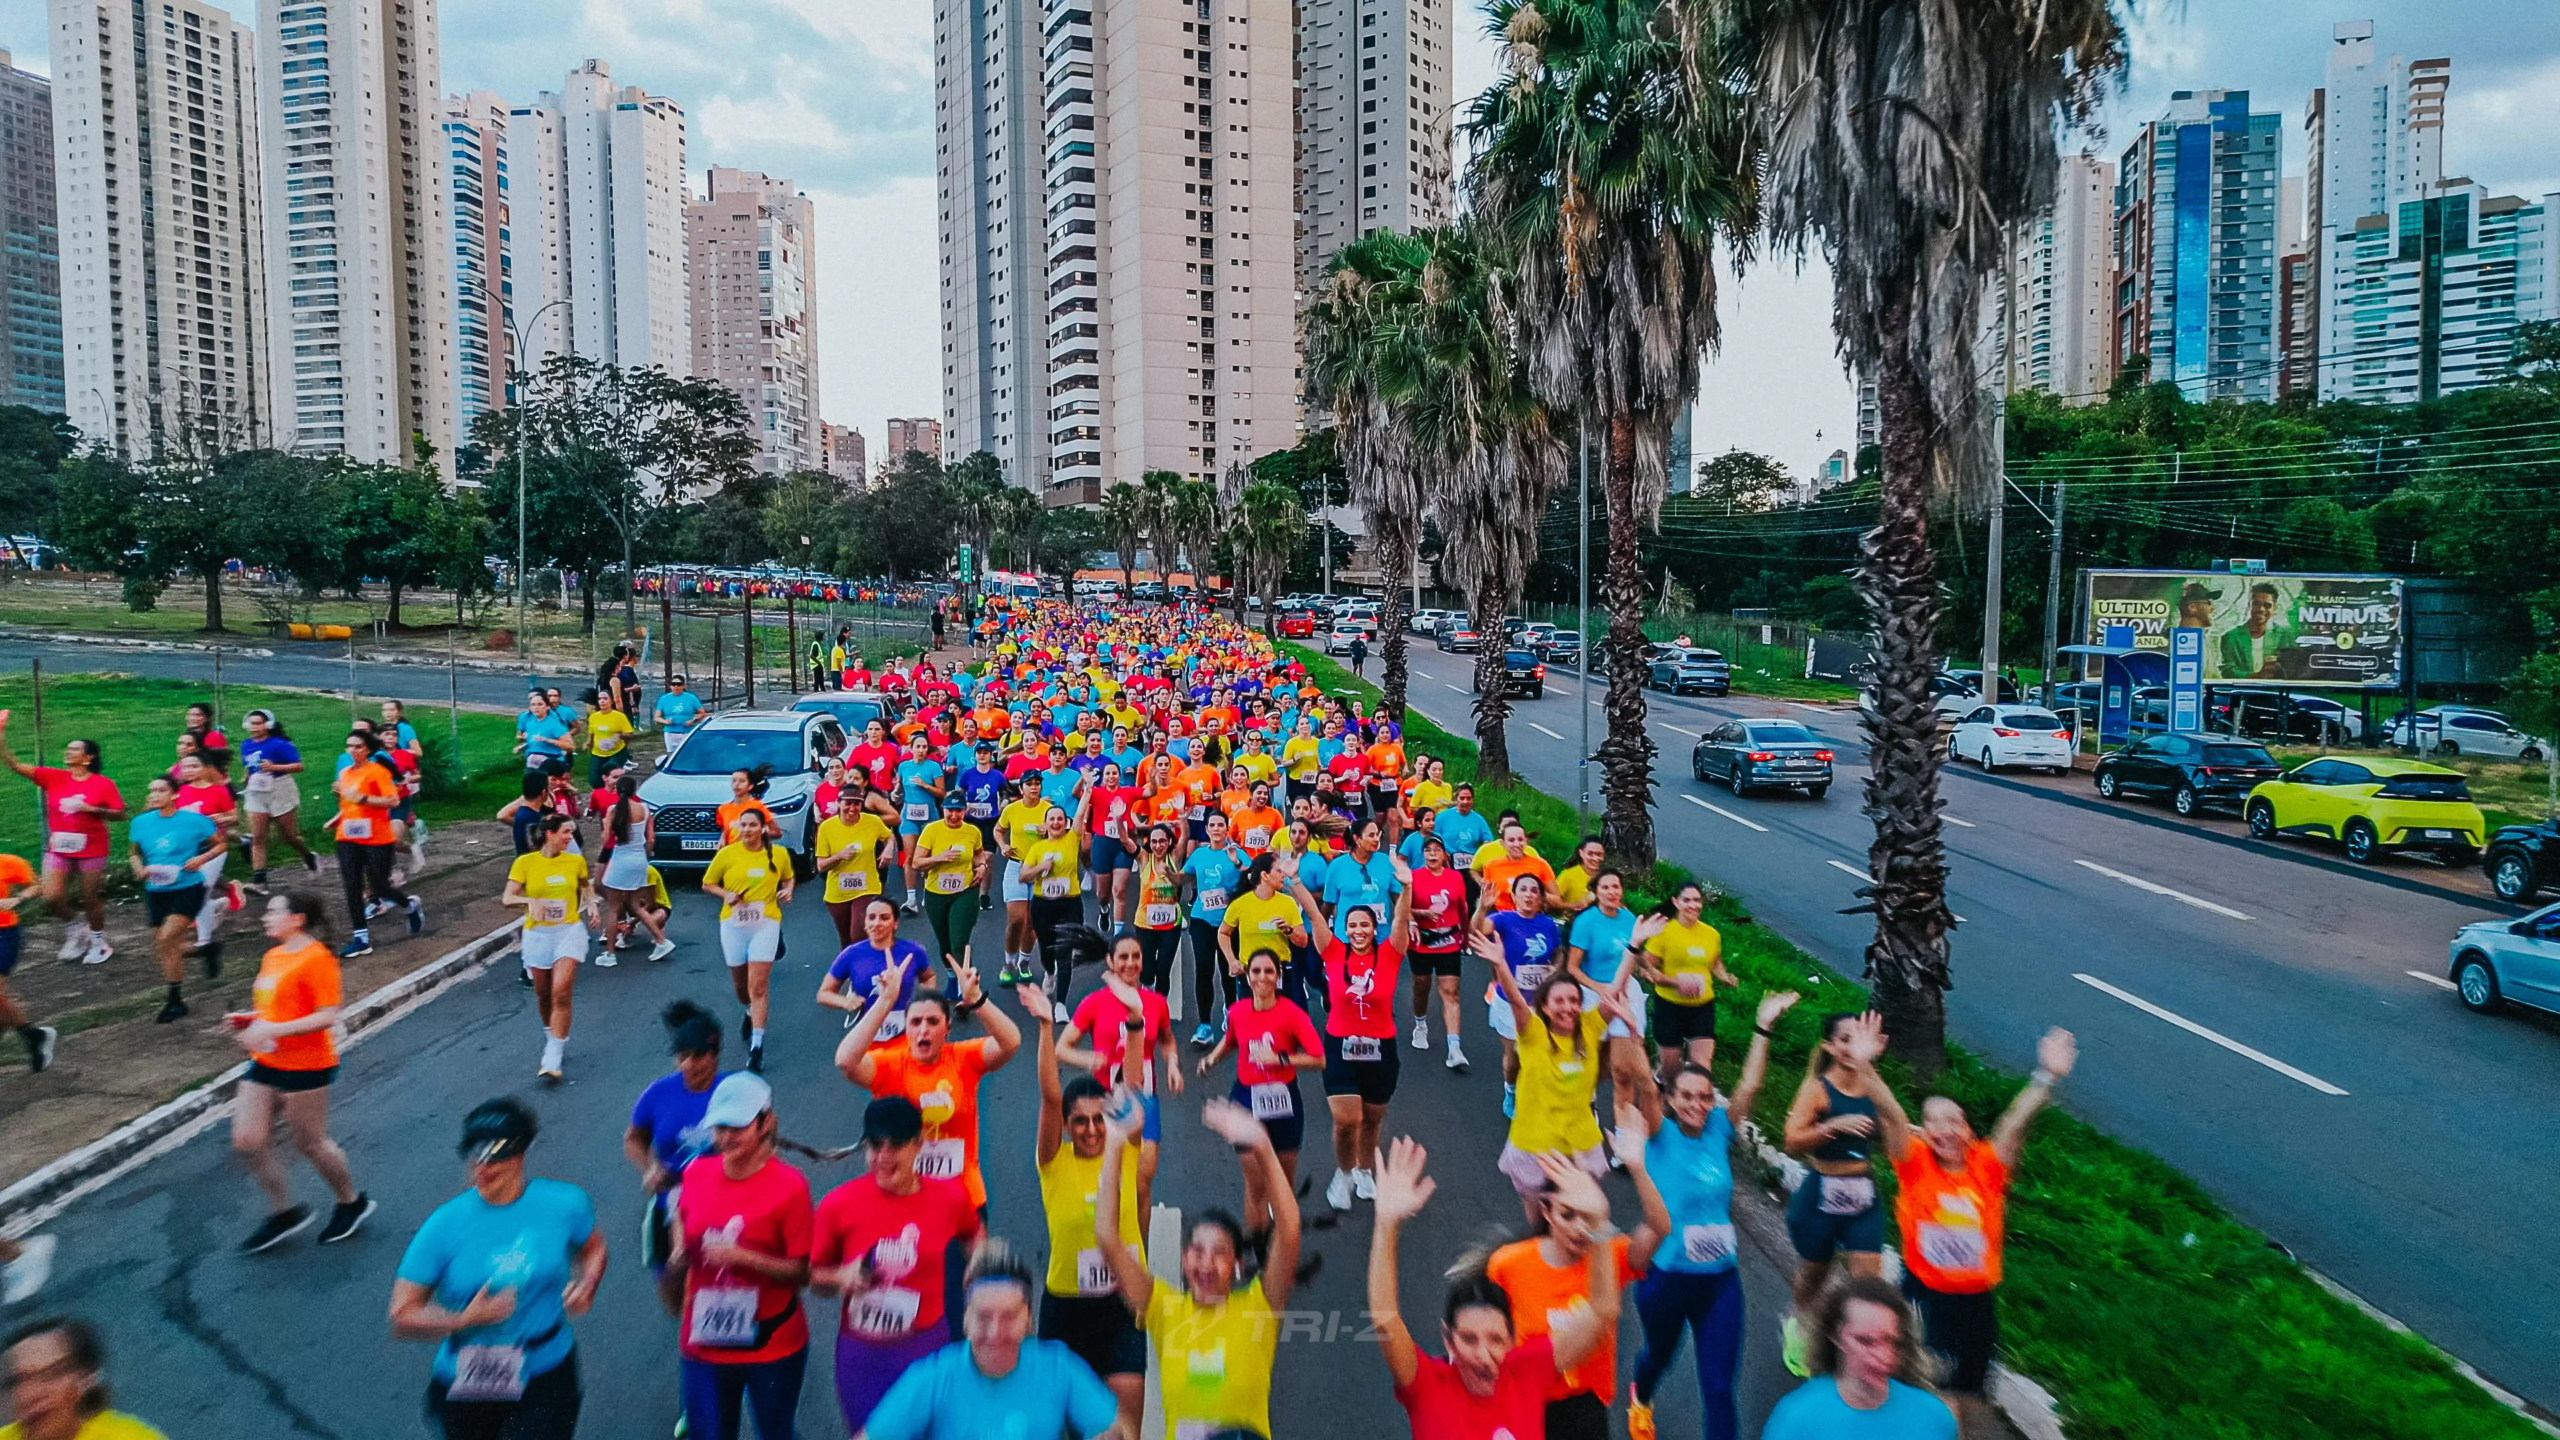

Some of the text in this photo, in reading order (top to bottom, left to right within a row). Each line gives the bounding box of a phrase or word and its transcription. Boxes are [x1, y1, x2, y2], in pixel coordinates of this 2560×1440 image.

[2299, 606, 2390, 624] NATIRUTS
[1248, 837, 1266, 846] 3070
[843, 880, 862, 888] 3006
[942, 880, 960, 889] 2107
[1151, 911, 1171, 922] 4337
